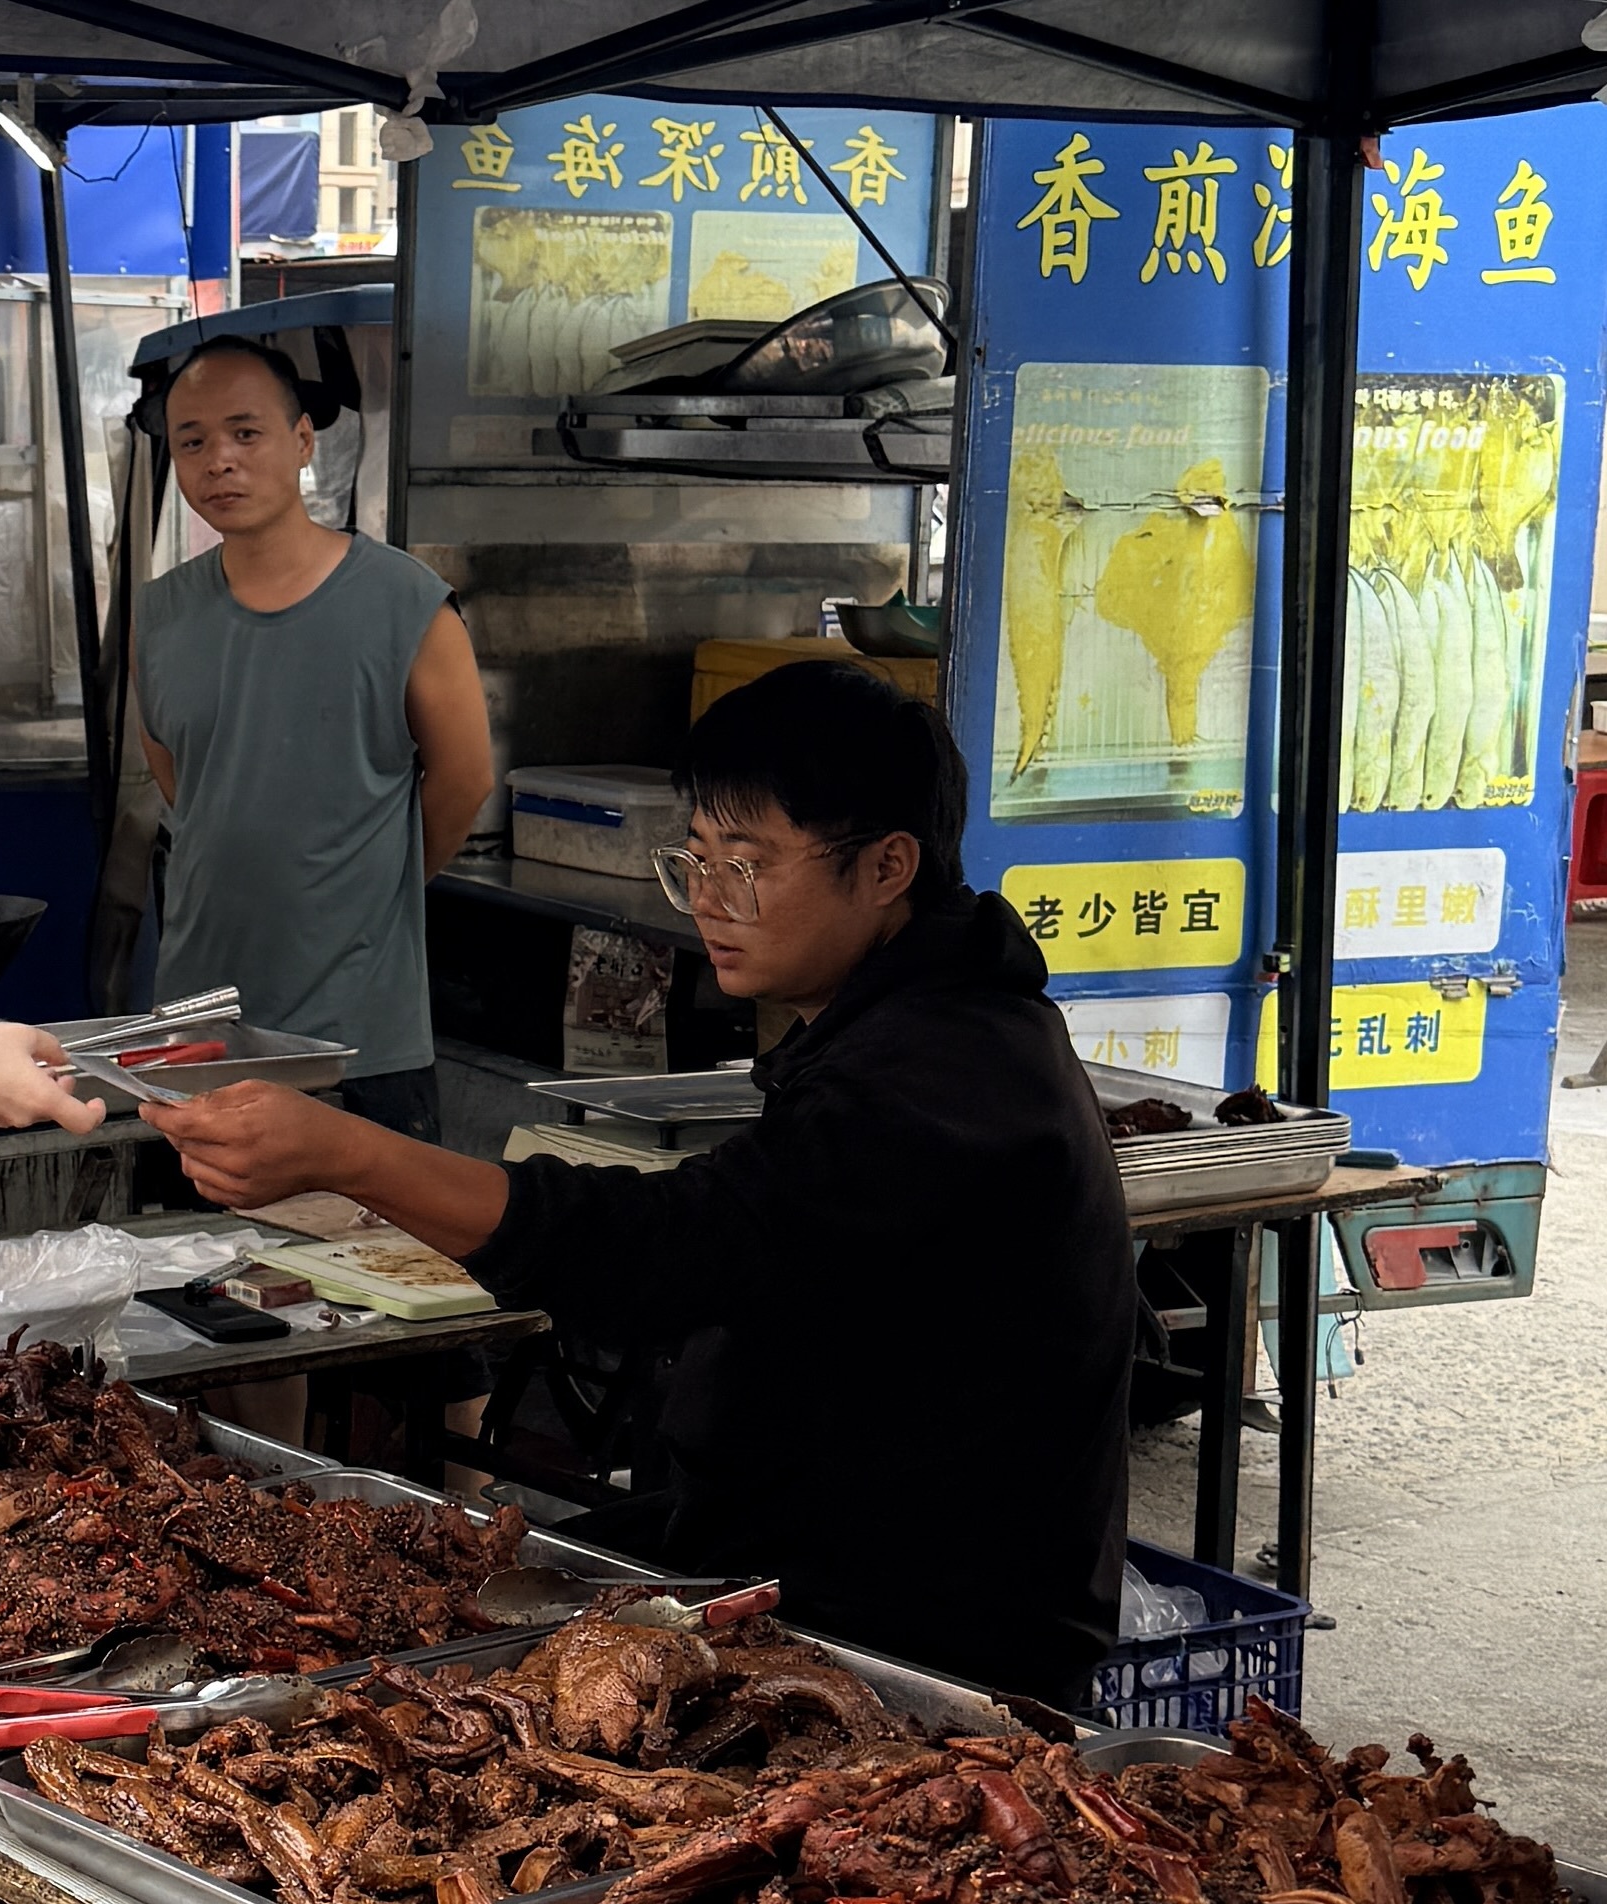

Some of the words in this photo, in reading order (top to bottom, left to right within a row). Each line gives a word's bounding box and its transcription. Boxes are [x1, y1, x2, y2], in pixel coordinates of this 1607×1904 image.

[1124, 423, 1193, 450] food
[1024, 888, 1221, 939] 老少皆宜
